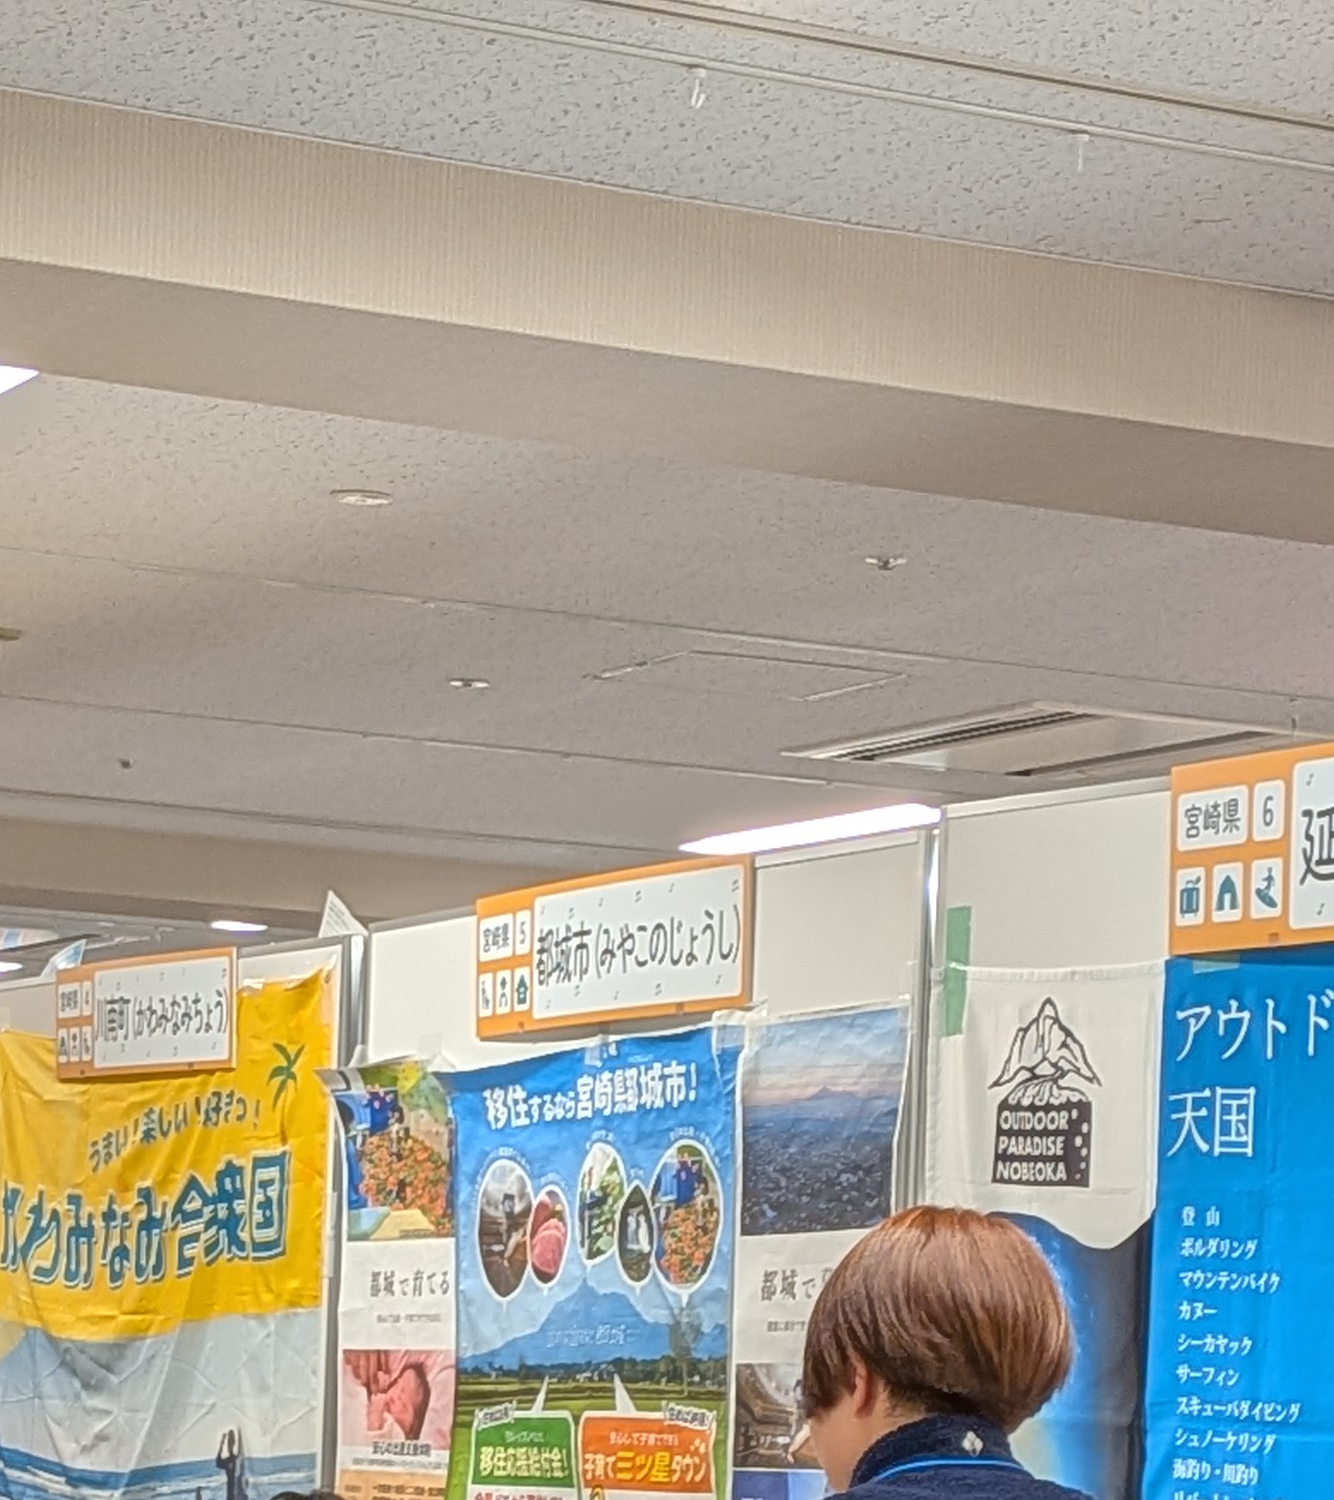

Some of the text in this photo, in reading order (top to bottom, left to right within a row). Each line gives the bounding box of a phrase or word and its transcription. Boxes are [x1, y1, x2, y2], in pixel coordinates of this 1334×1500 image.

[1184, 801, 1242, 839] 宮崎県
[1262, 795, 1274, 828] 6
[482, 922, 510, 953] 宮崎県
[519, 921, 526, 944] 5
[536, 904, 741, 986] 都城市(みやこのじょうし)
[96, 987, 228, 1043] 川南町(かわみなみちょう)
[999, 1110, 1069, 1130] OUTDOOR
[1167, 1085, 1255, 1159] 天国
[997, 1135, 1065, 1156] PARADISE
[996, 1160, 1068, 1181] NOBEOKA
[1, 1147, 291, 1291] かわみなみ合衆国
[1180, 1205, 1220, 1229] 登山
[1179, 1236, 1258, 1262] ボルダリング
[369, 1268, 451, 1299] 都城で育てる
[1179, 1269, 1281, 1295] マウンテンバイク
[1178, 1299, 1219, 1322] カヌー
[1177, 1333, 1254, 1357] シーカヤック
[1175, 1364, 1241, 1388] サーフィン
[1176, 1396, 1302, 1424] スキューバダイビング
[1174, 1430, 1277, 1455] シュノーケリング
[583, 1449, 707, 1484] 子育て三ツ星タウン
